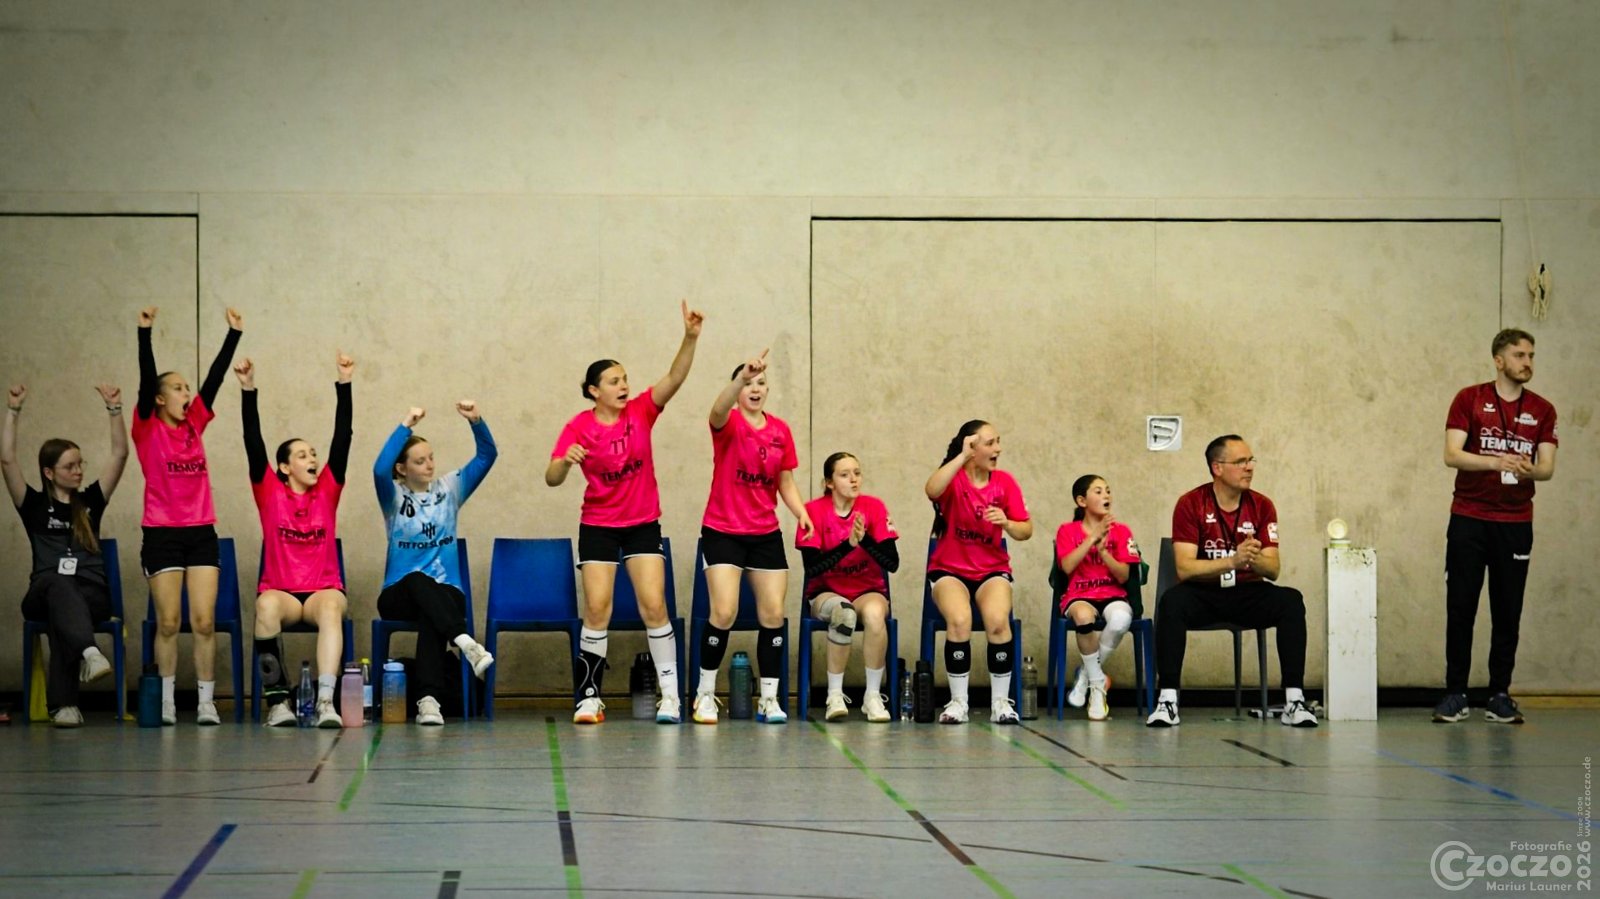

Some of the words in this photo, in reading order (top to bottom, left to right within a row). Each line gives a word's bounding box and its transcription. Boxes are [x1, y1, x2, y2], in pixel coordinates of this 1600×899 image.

[1479, 436, 1533, 454] TEMPUR
[759, 447, 767, 460] 9
[400, 495, 415, 518] 16
[398, 541, 411, 549] FIT
[1205, 549, 1236, 560] TEM
